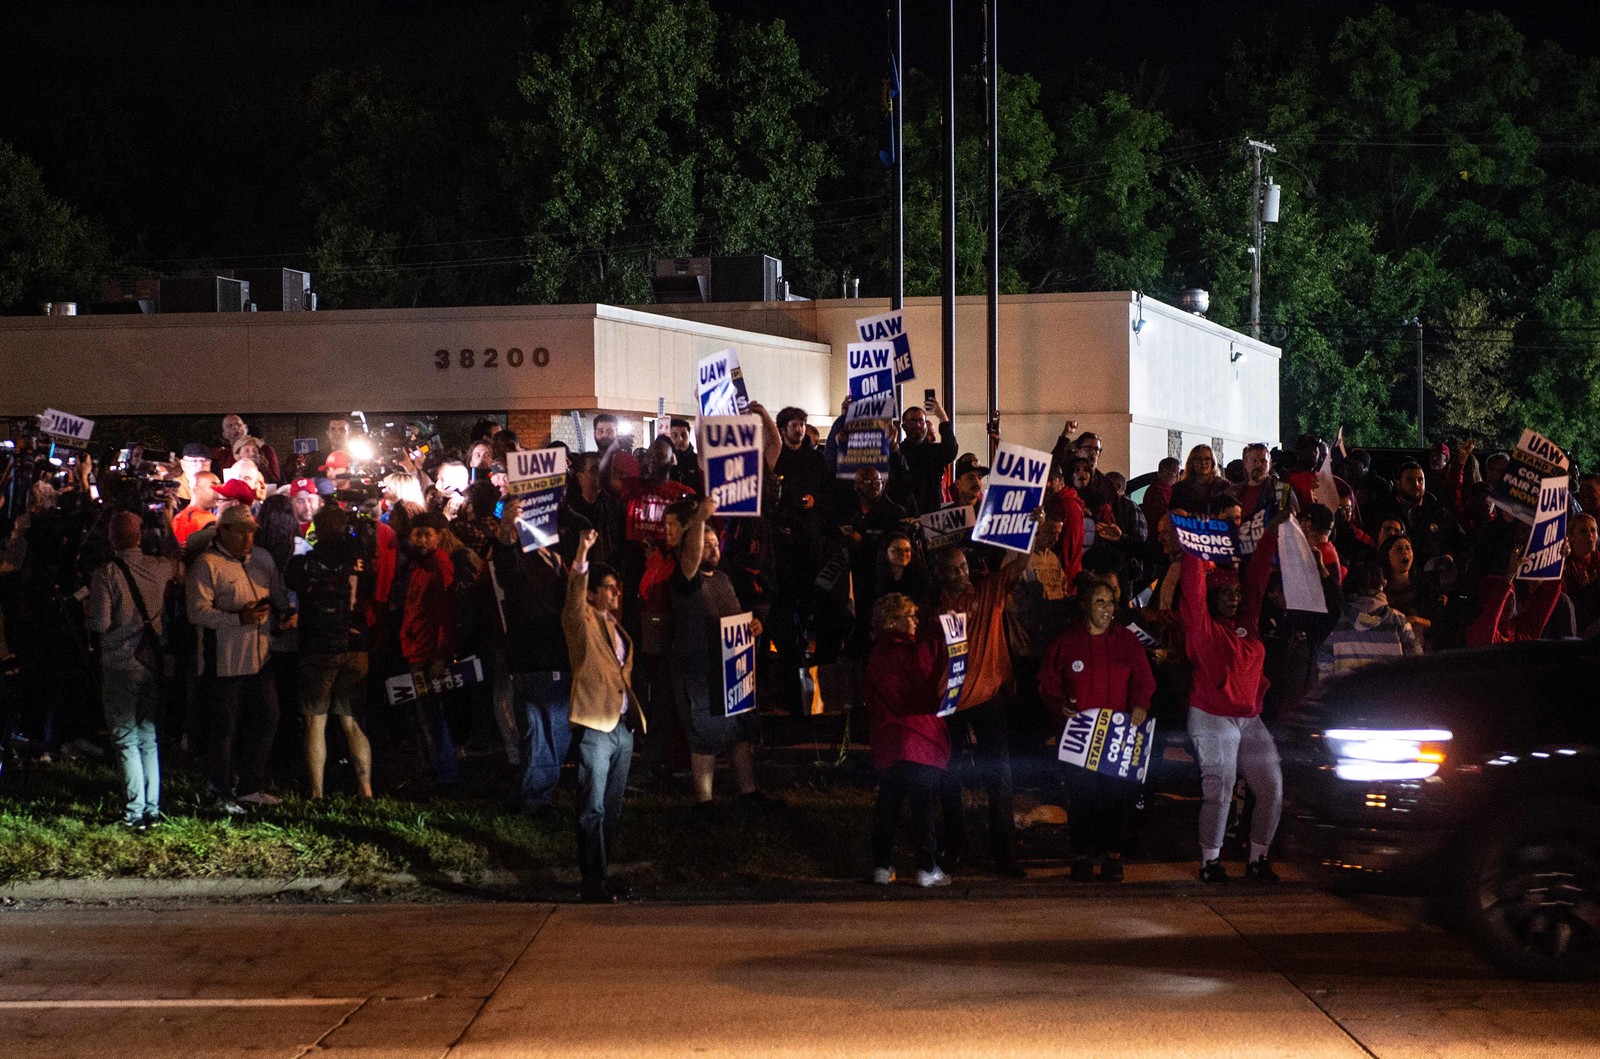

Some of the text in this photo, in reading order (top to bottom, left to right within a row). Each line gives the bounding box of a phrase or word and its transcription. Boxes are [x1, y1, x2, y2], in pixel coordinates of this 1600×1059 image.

[860, 316, 902, 342] UAW
[434, 347, 550, 369] 38200
[850, 349, 889, 369] UAW
[700, 358, 727, 385] UAW
[861, 374, 879, 396] ON
[706, 425, 756, 447] UAW
[1528, 435, 1564, 465] UAW
[517, 452, 556, 476] UAW
[723, 455, 745, 481] ON
[996, 452, 1047, 484] UAW
[1518, 467, 1541, 483] COL
[513, 476, 563, 493] STAND UP
[711, 474, 757, 511] STRIKE
[1002, 490, 1027, 512] ON
[1540, 487, 1567, 512] UAW
[930, 509, 966, 530] UAW
[979, 513, 1034, 537] STRIKE
[1171, 514, 1230, 533] UNITED
[1543, 520, 1559, 546] ON
[1522, 538, 1565, 574] STRIKE
[735, 653, 747, 681] ON
[952, 660, 965, 673] COLA
[728, 670, 754, 710] STRIKE
[1062, 713, 1094, 754] UAW
[1089, 711, 1109, 766] STAND UP
[1107, 726, 1126, 763] COLA
[1118, 745, 1133, 777] FAIR
[1126, 723, 1138, 745] PA
[1131, 732, 1144, 766] NOW
